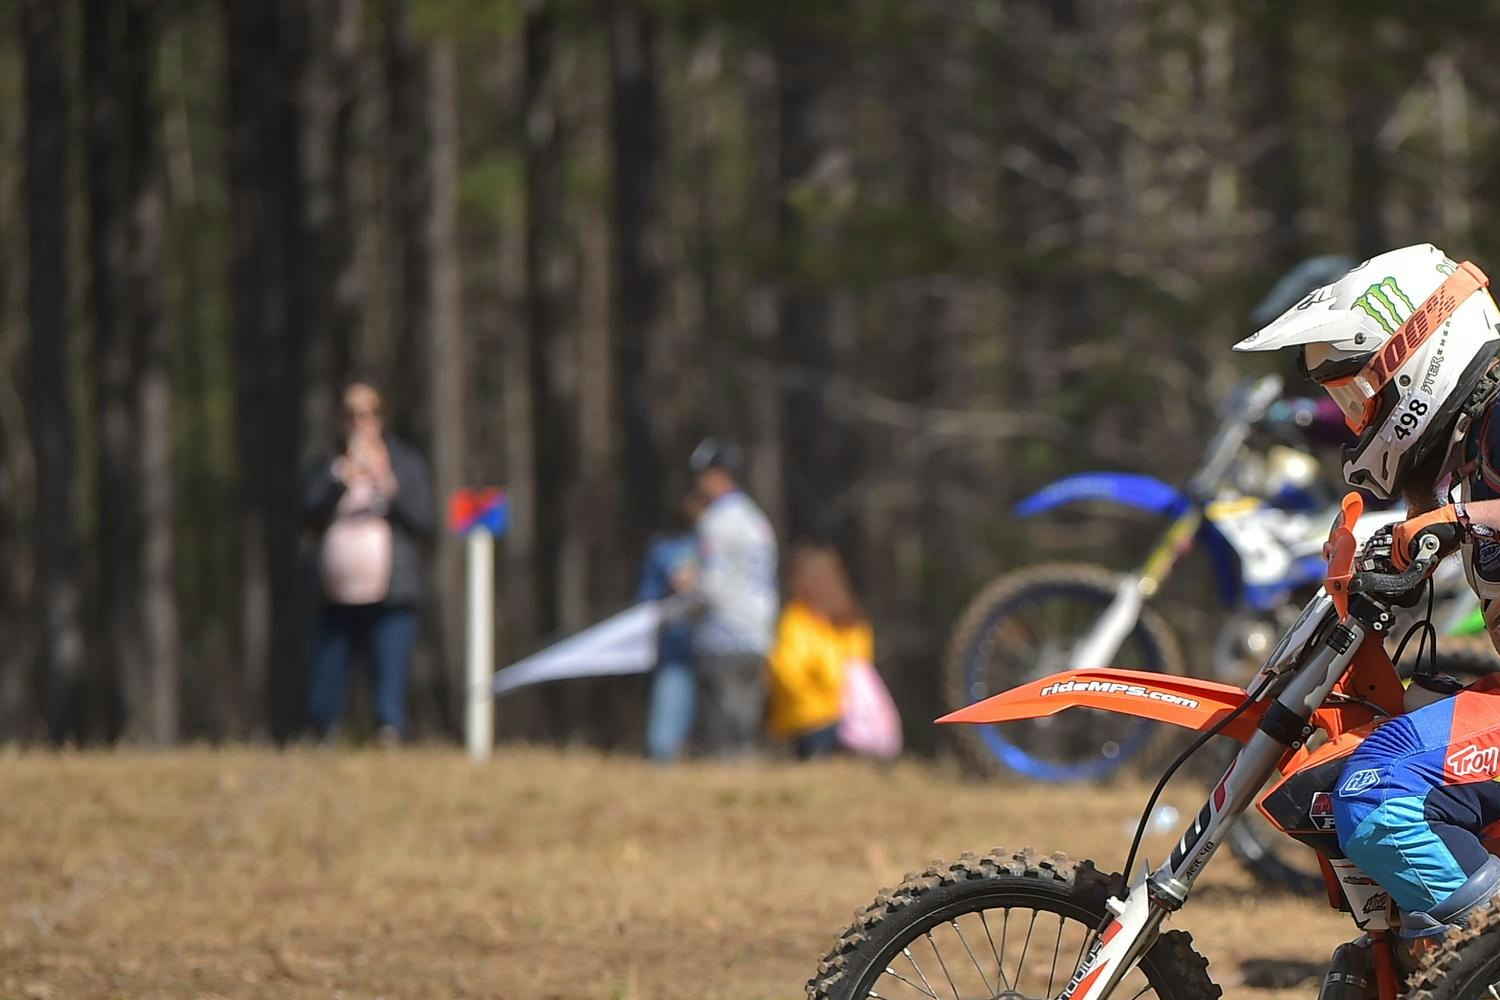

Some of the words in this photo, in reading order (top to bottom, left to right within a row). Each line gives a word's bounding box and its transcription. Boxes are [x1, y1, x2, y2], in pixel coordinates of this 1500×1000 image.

[1371, 284, 1456, 386] 100%
[1393, 398, 1429, 441] 498
[1040, 681, 1199, 709] rideMPS.com
[1447, 744, 1499, 776] Troy
[1186, 860, 1202, 881] AER
